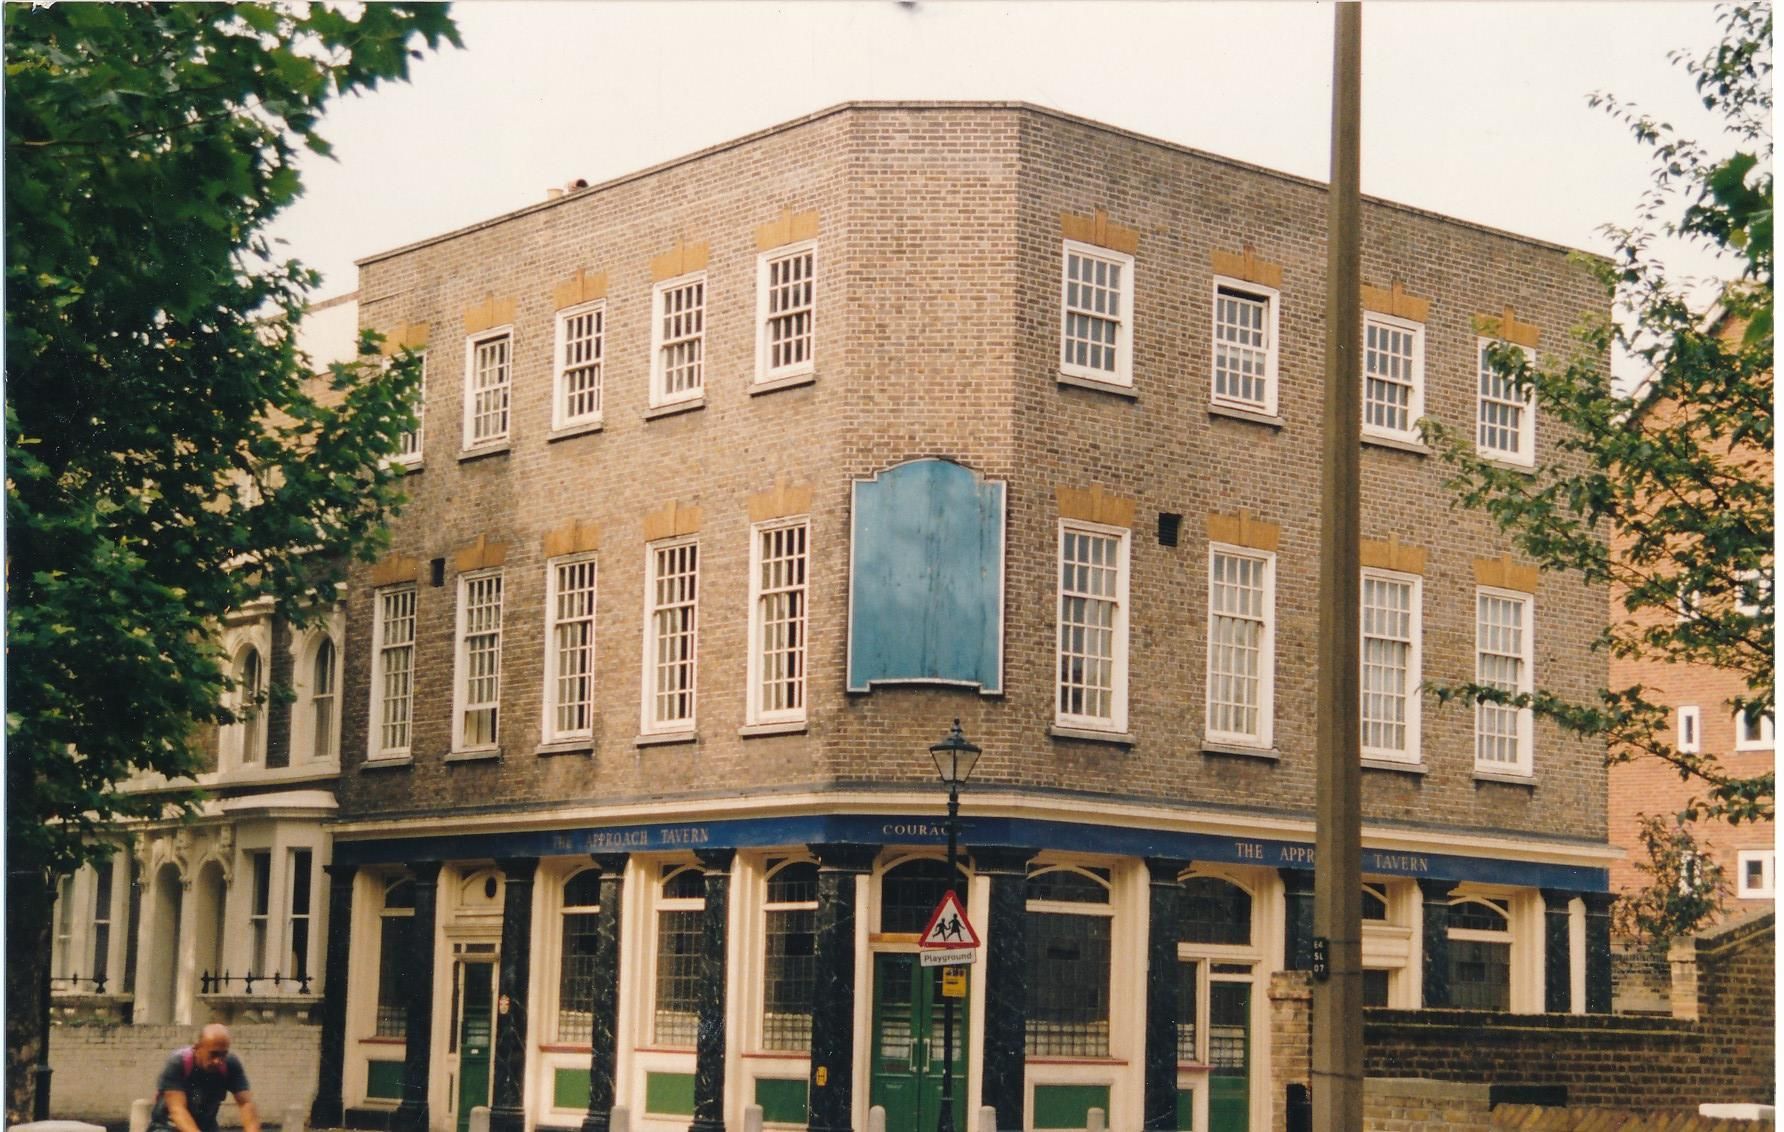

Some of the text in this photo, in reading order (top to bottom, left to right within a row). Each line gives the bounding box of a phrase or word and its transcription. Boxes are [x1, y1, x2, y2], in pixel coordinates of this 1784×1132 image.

[586, 830, 648, 849] APPROACH
[661, 827, 709, 844] TAVERN
[882, 824, 962, 837] COURAG
[1235, 843, 1428, 872] THE APPR TAVERN
[924, 952, 973, 964] Playground
